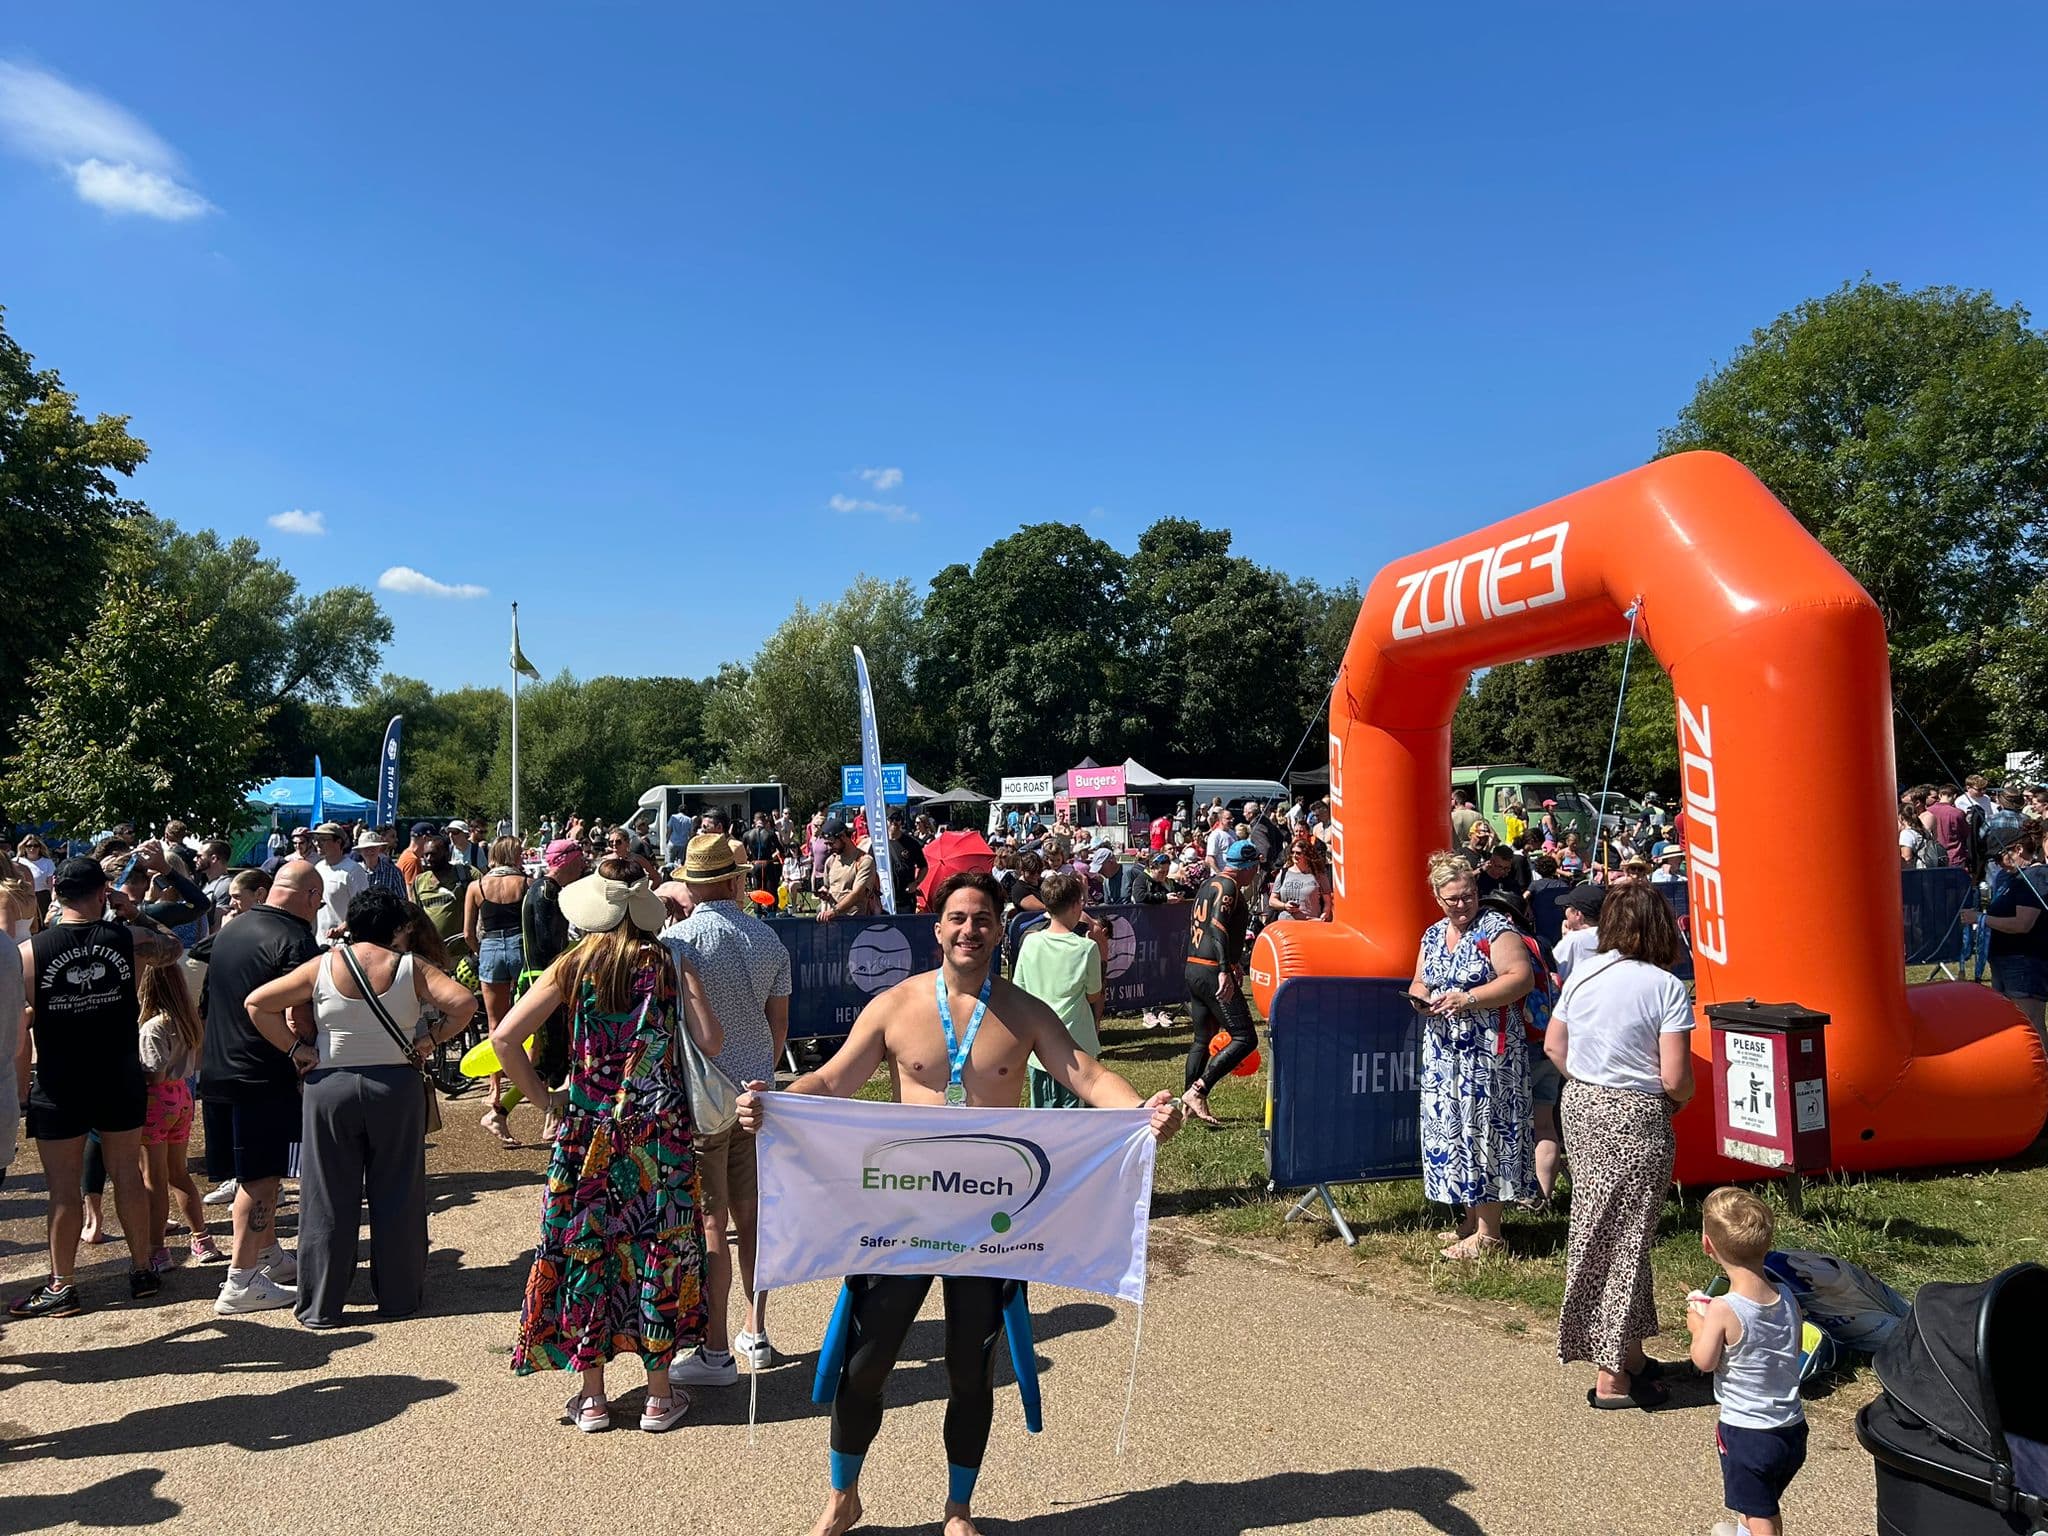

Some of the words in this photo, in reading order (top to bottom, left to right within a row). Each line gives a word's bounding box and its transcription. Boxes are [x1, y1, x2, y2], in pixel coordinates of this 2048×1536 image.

[1391, 521, 1570, 641] ZONE3
[1004, 782, 1022, 793] HOG
[1023, 781, 1049, 792] ROAST
[1075, 774, 1117, 791] Burgers
[1678, 696, 1728, 965] ZONE3
[40, 946, 89, 989] VANQUISH
[92, 944, 131, 981] FITNESS
[1118, 983, 1145, 1000] SWIM
[835, 1006, 865, 1024] HEN
[1733, 1038, 1766, 1053] PLEASE
[1351, 1051, 1421, 1094] HENL
[862, 1167, 1013, 1196] EnerMech
[860, 1236, 897, 1248] Safer
[910, 1236, 967, 1253] Smarter
